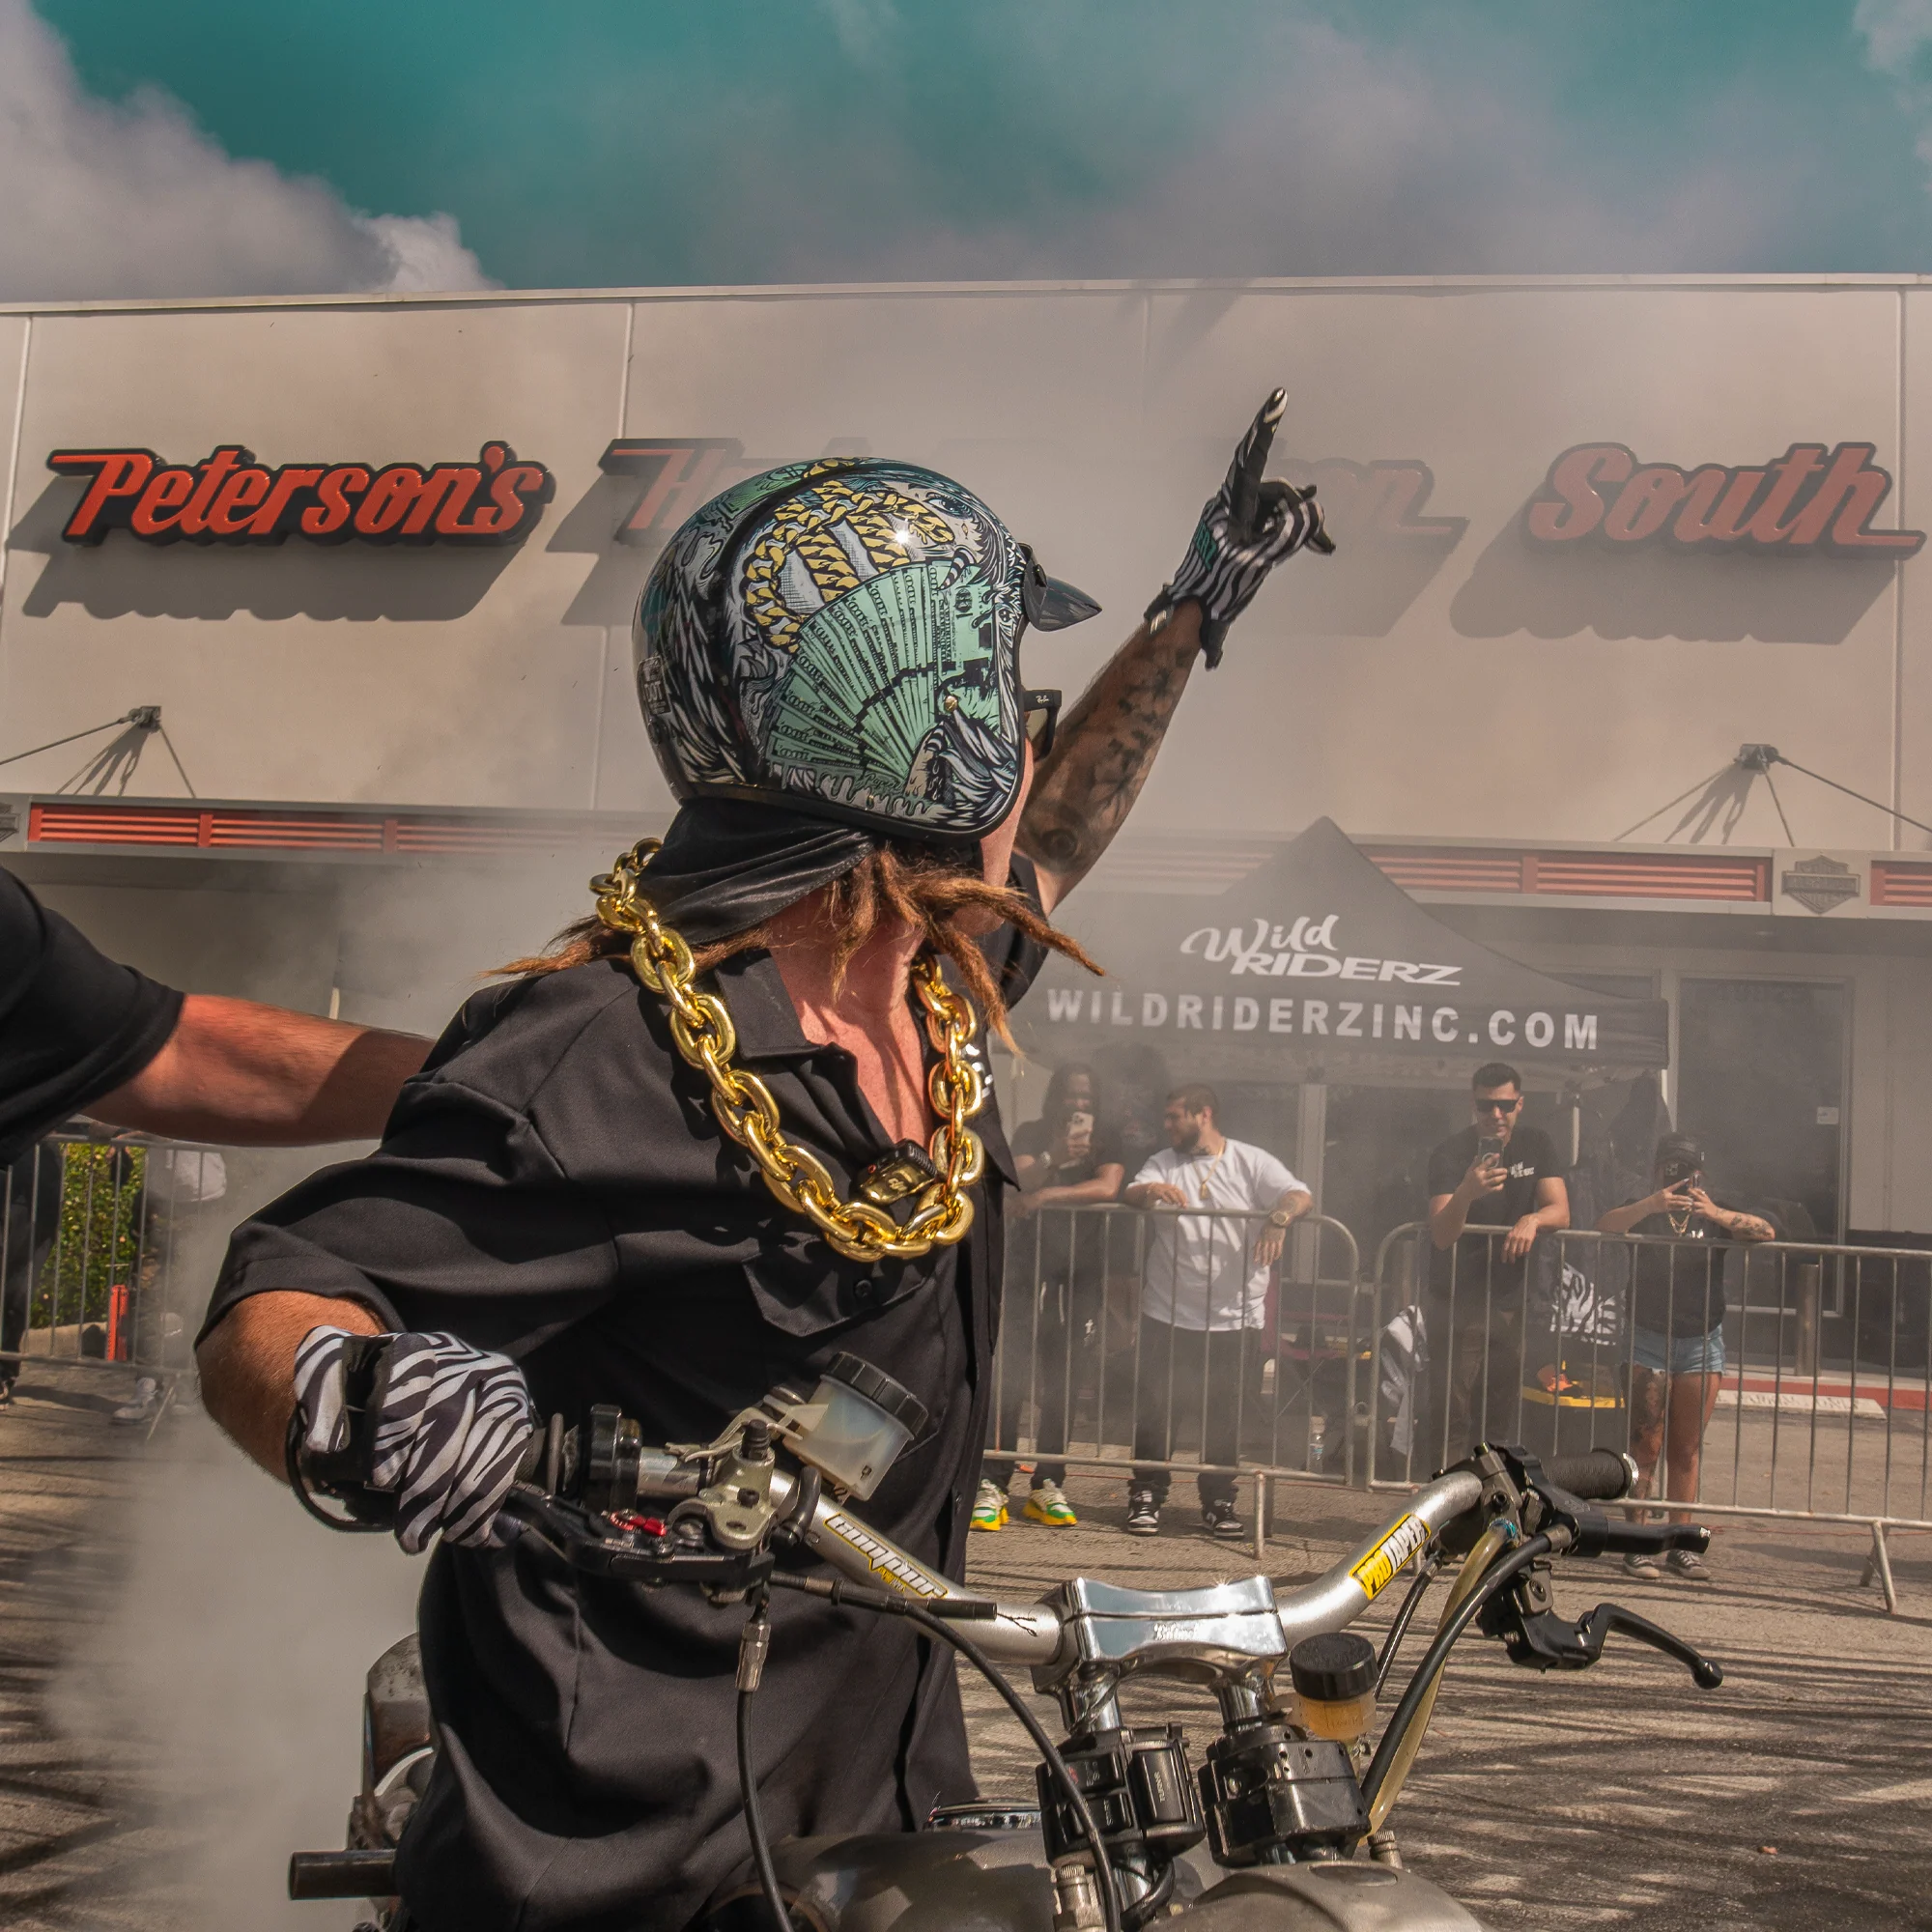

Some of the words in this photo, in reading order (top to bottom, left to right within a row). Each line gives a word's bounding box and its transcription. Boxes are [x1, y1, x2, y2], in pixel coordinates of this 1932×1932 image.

[48, 441, 555, 544] Peterson's
[1525, 443, 1925, 554] South
[1179, 913, 1341, 962] Wild
[1230, 952, 1463, 986] RIDERZ
[1046, 988, 1600, 1051] WILDRIDERZINC.COM
